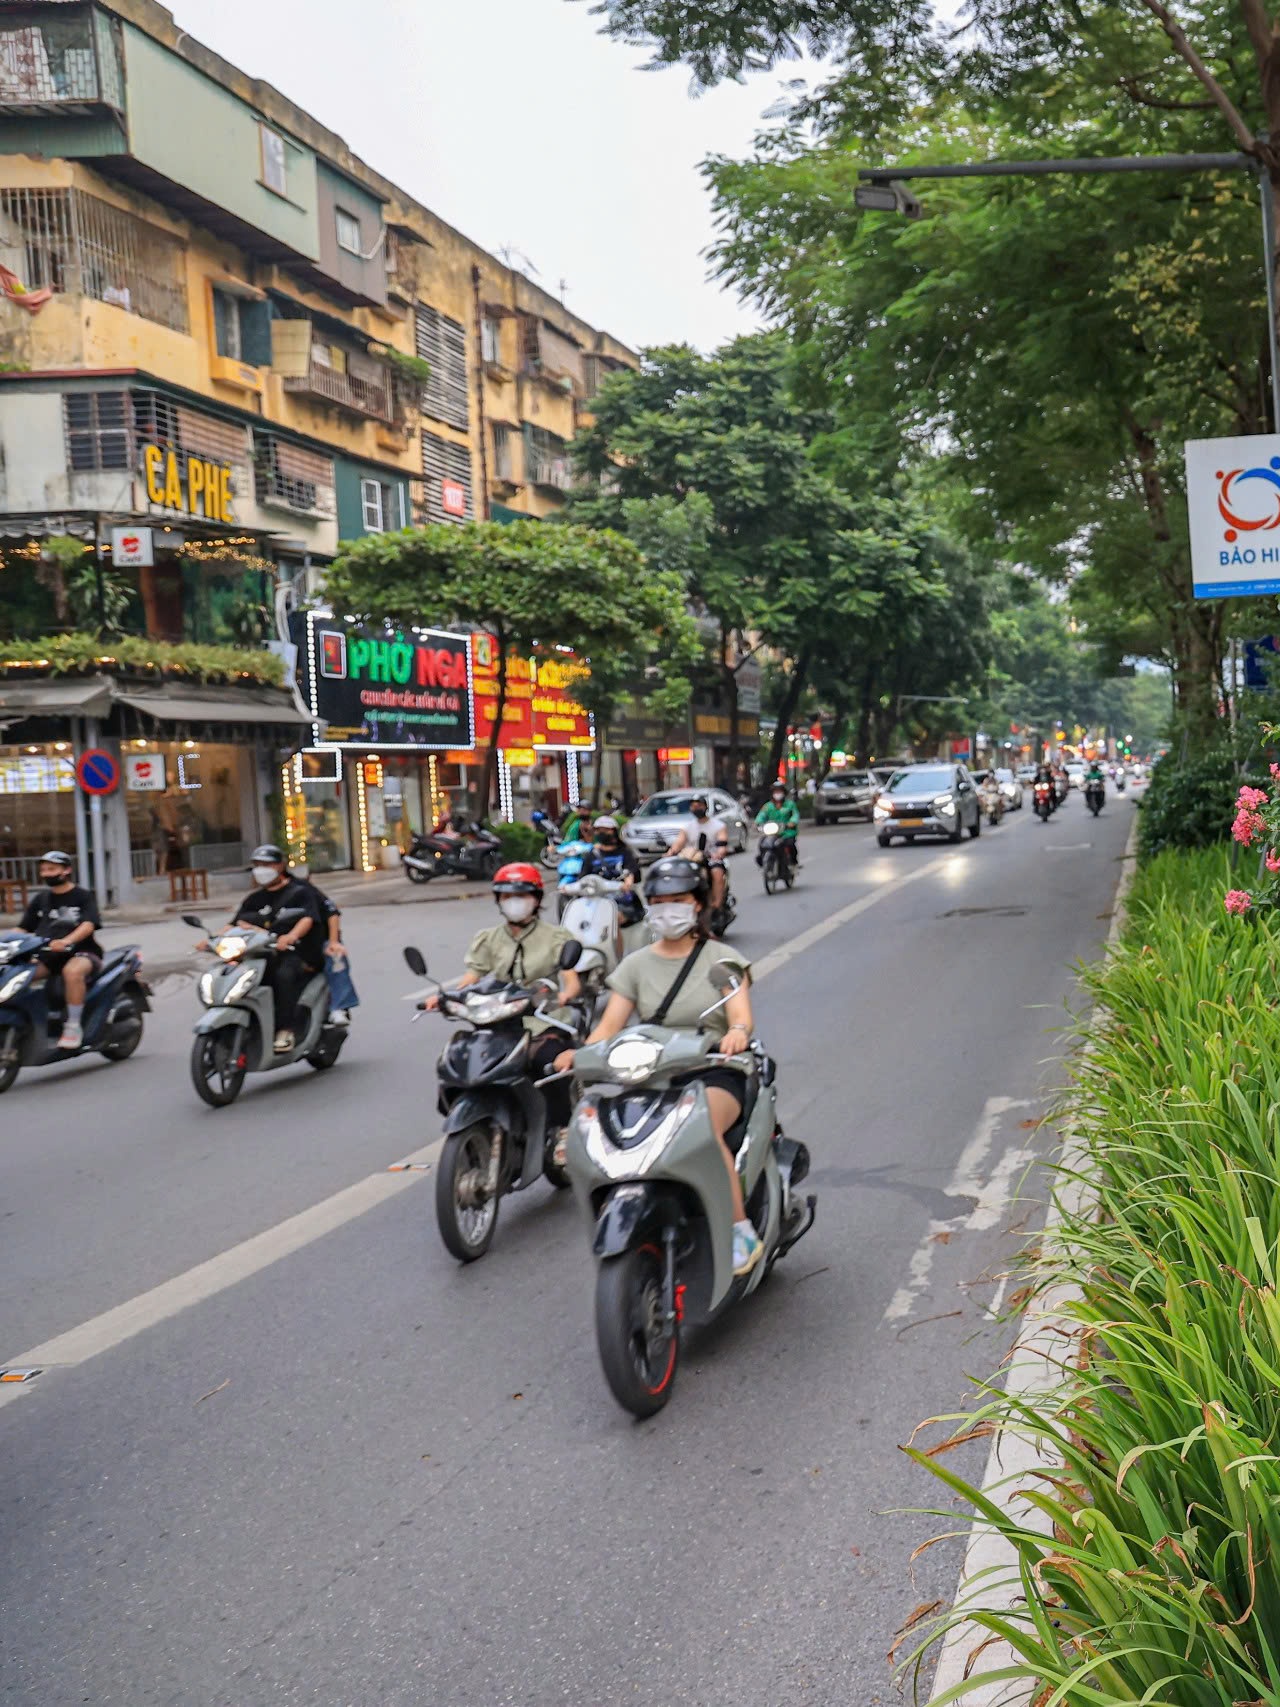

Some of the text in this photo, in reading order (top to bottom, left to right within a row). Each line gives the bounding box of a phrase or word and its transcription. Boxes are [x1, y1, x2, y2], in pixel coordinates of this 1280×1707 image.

[145, 440, 234, 523] CÀ PHÊ
[1219, 545, 1256, 566] BẢO
[348, 630, 414, 685] PHỞ
[417, 647, 467, 689] NGA
